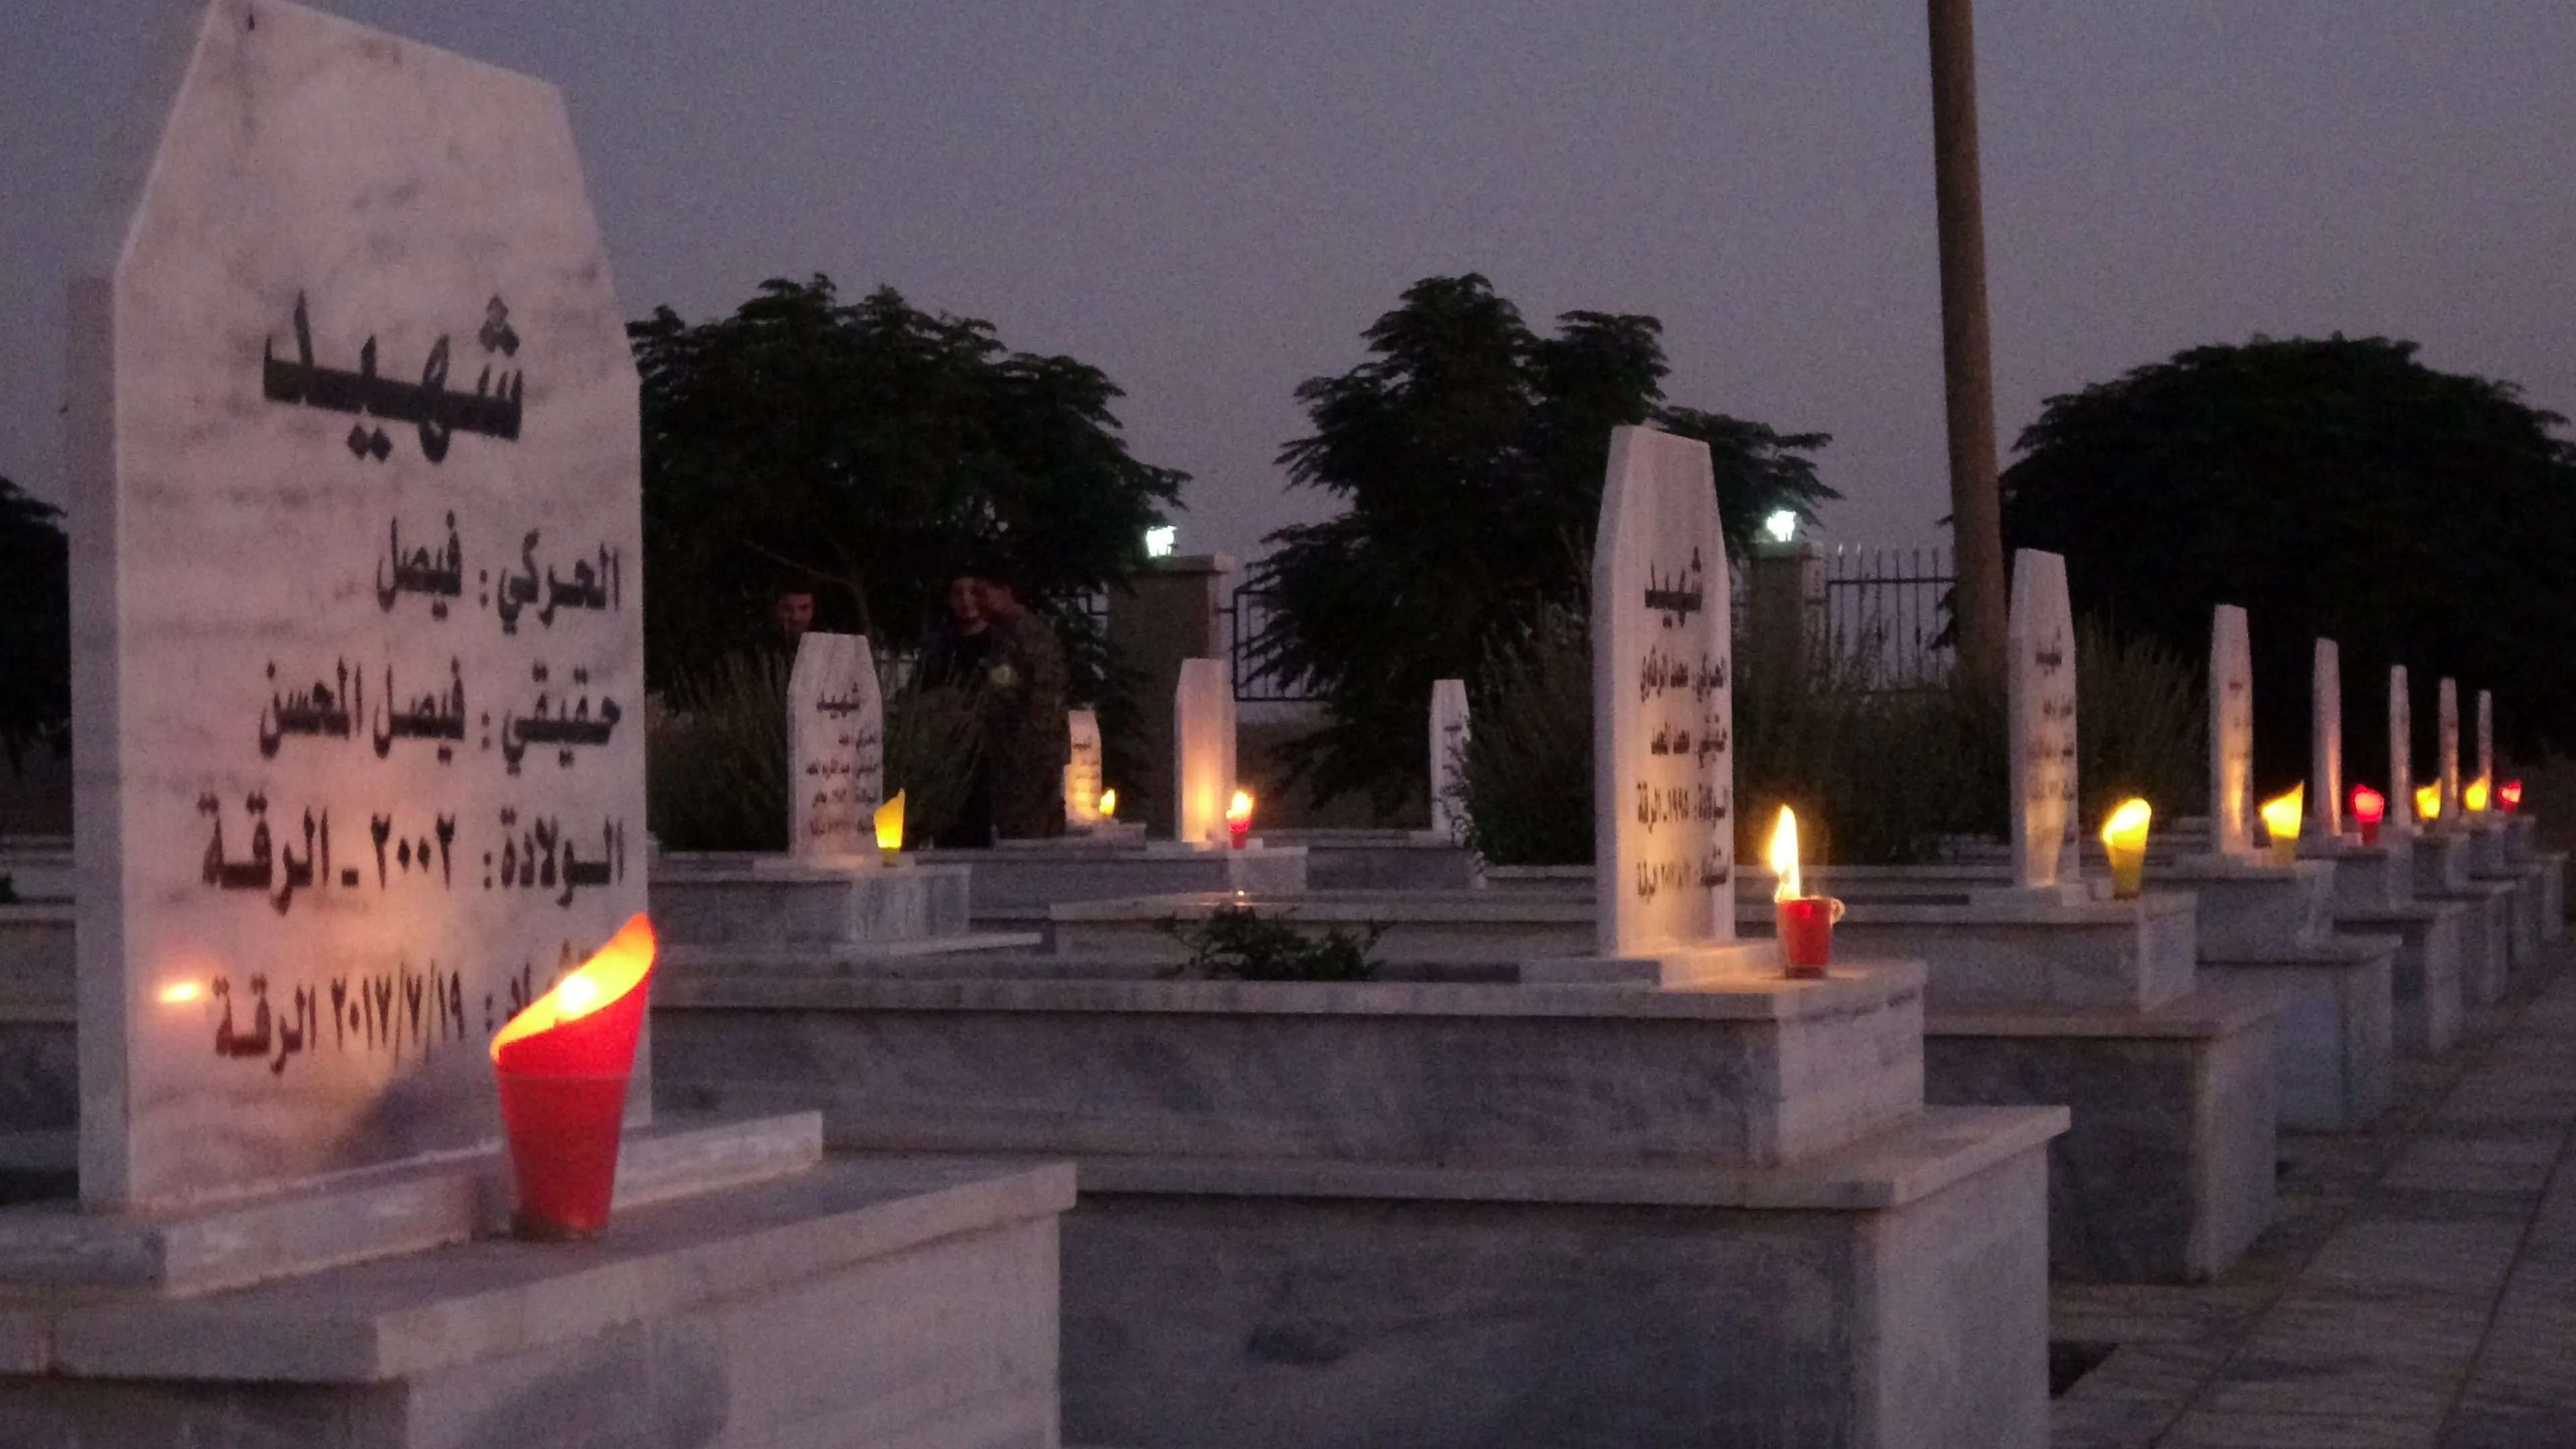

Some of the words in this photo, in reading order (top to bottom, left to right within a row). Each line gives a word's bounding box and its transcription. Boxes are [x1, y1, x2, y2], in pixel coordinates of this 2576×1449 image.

[263, 290, 523, 464] شهيد
[1644, 545, 1703, 630] شهيد
[197, 791, 329, 916] الرقة
